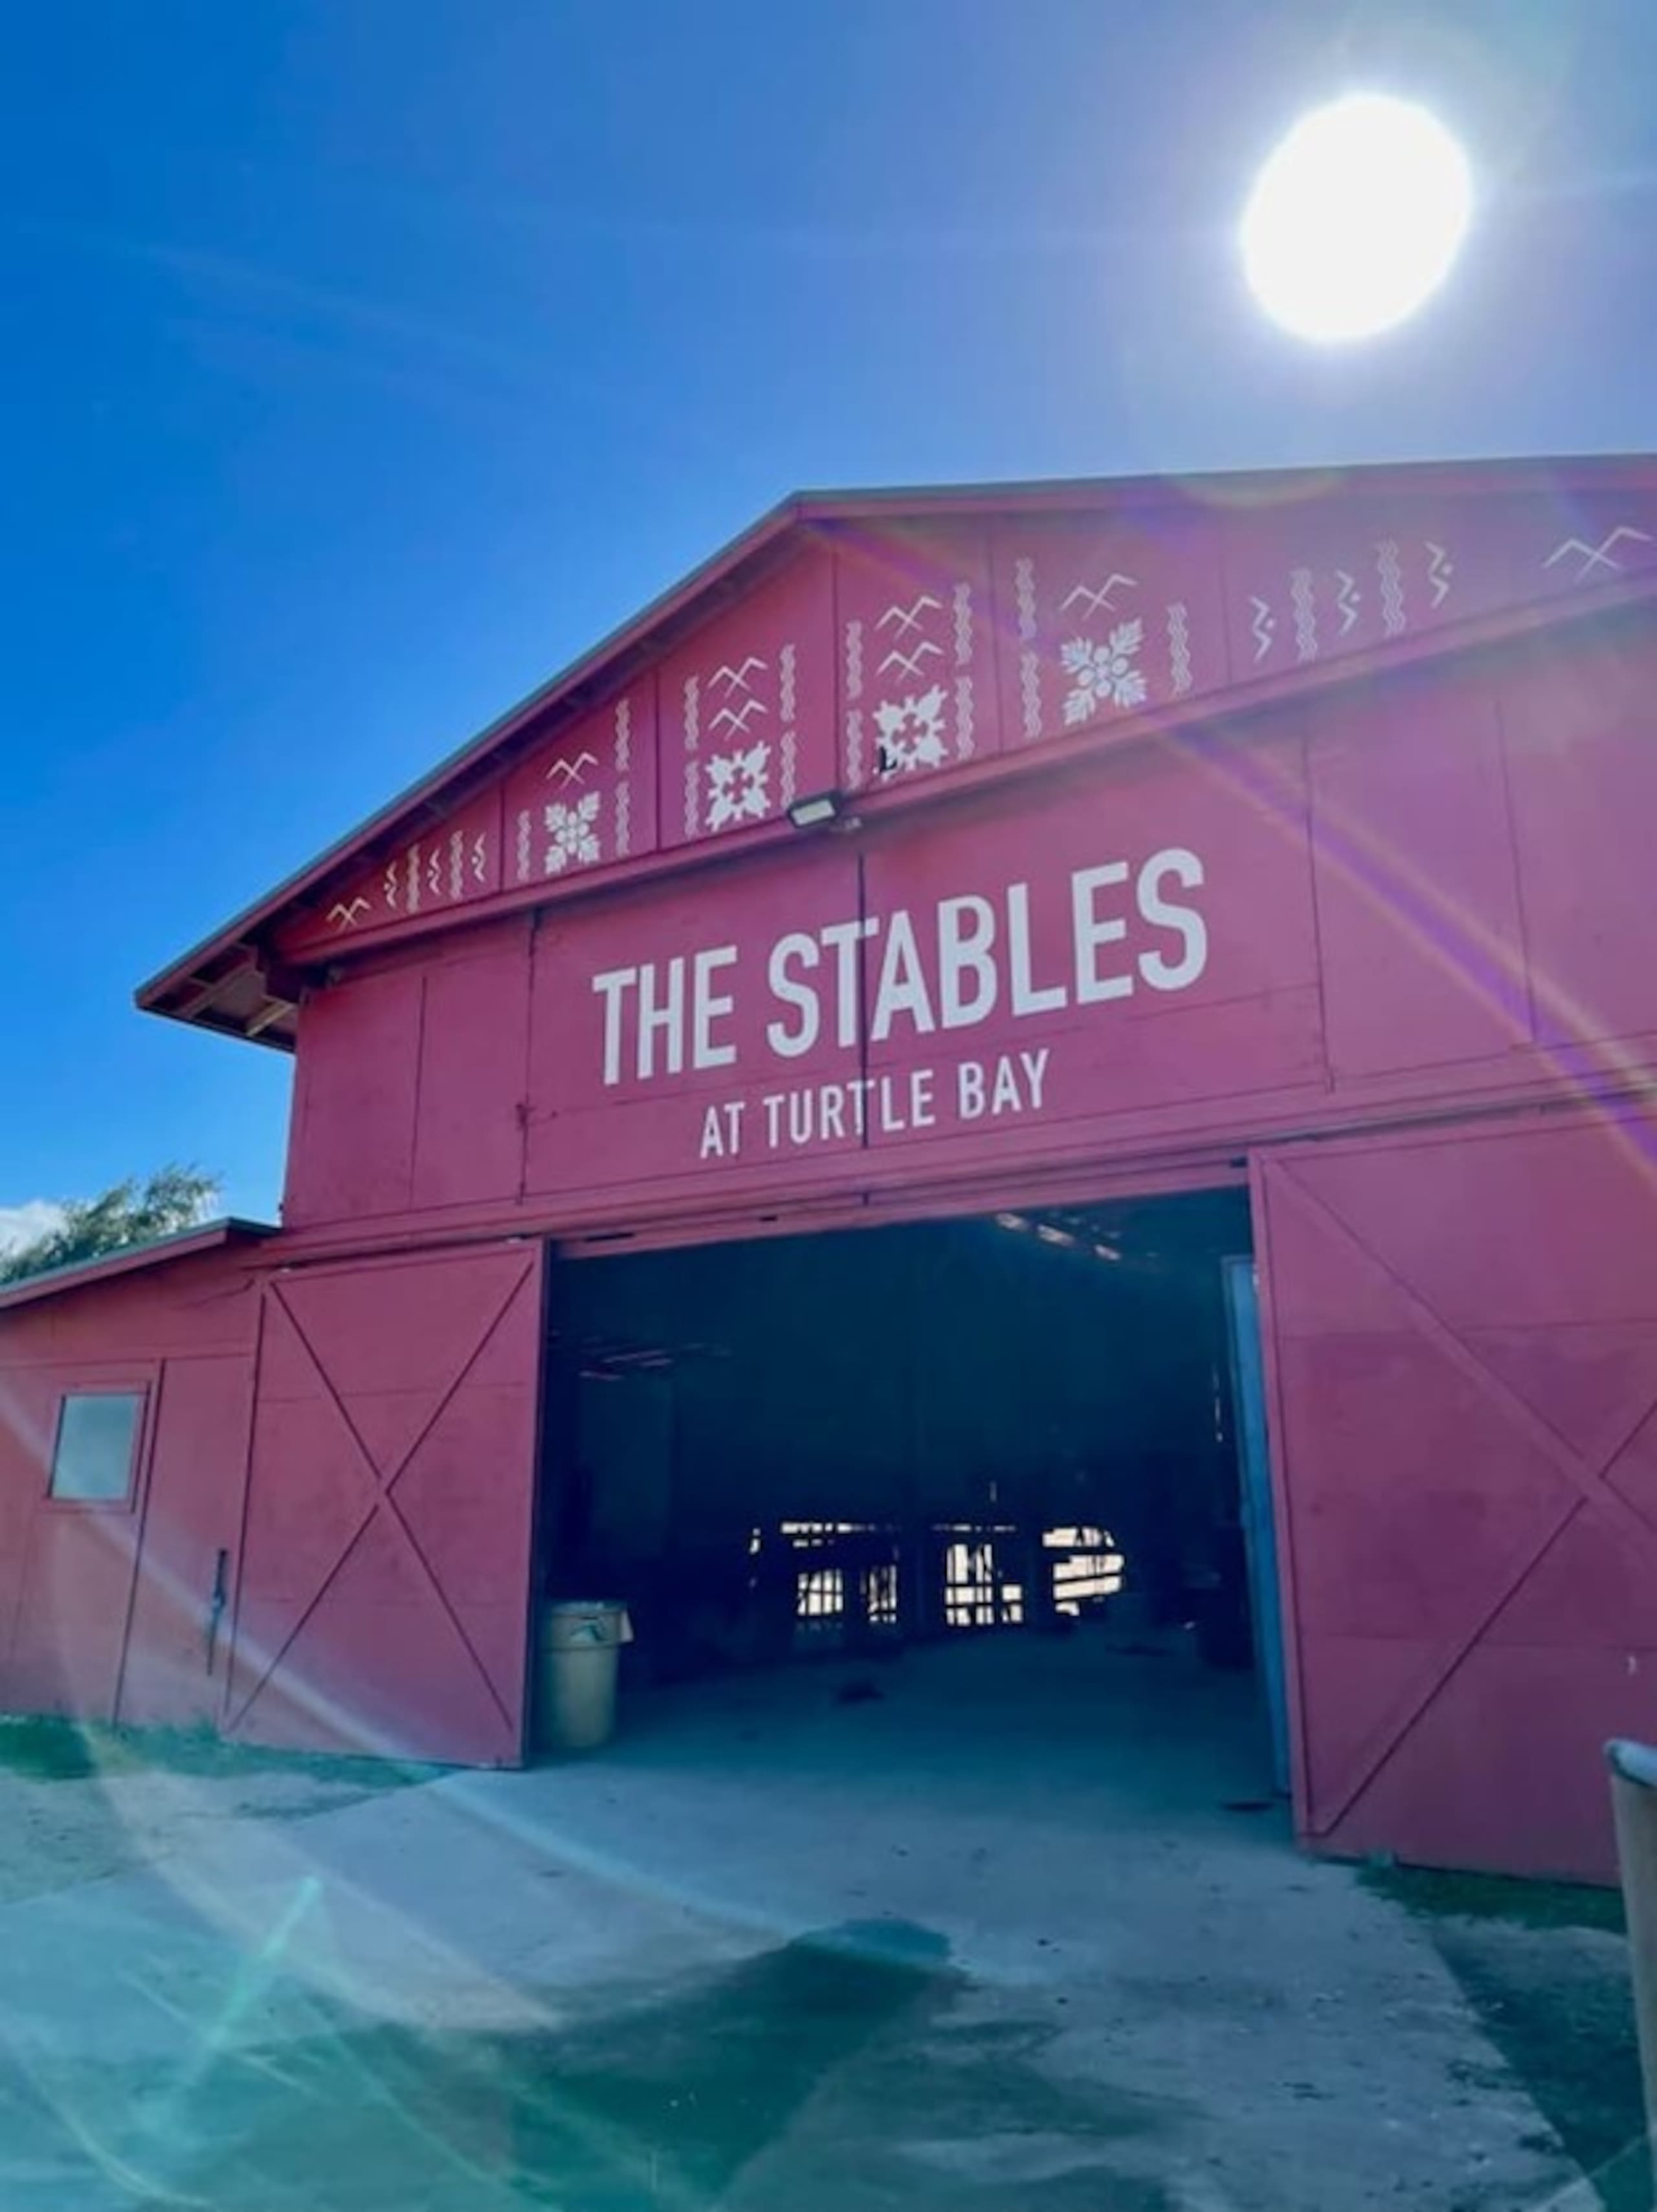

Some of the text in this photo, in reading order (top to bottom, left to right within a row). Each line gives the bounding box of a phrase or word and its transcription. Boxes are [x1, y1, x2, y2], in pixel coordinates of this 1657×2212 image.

[592, 847, 1208, 1086] THE STABLES
[699, 1048, 1049, 1159] AT TURTLE BAY
